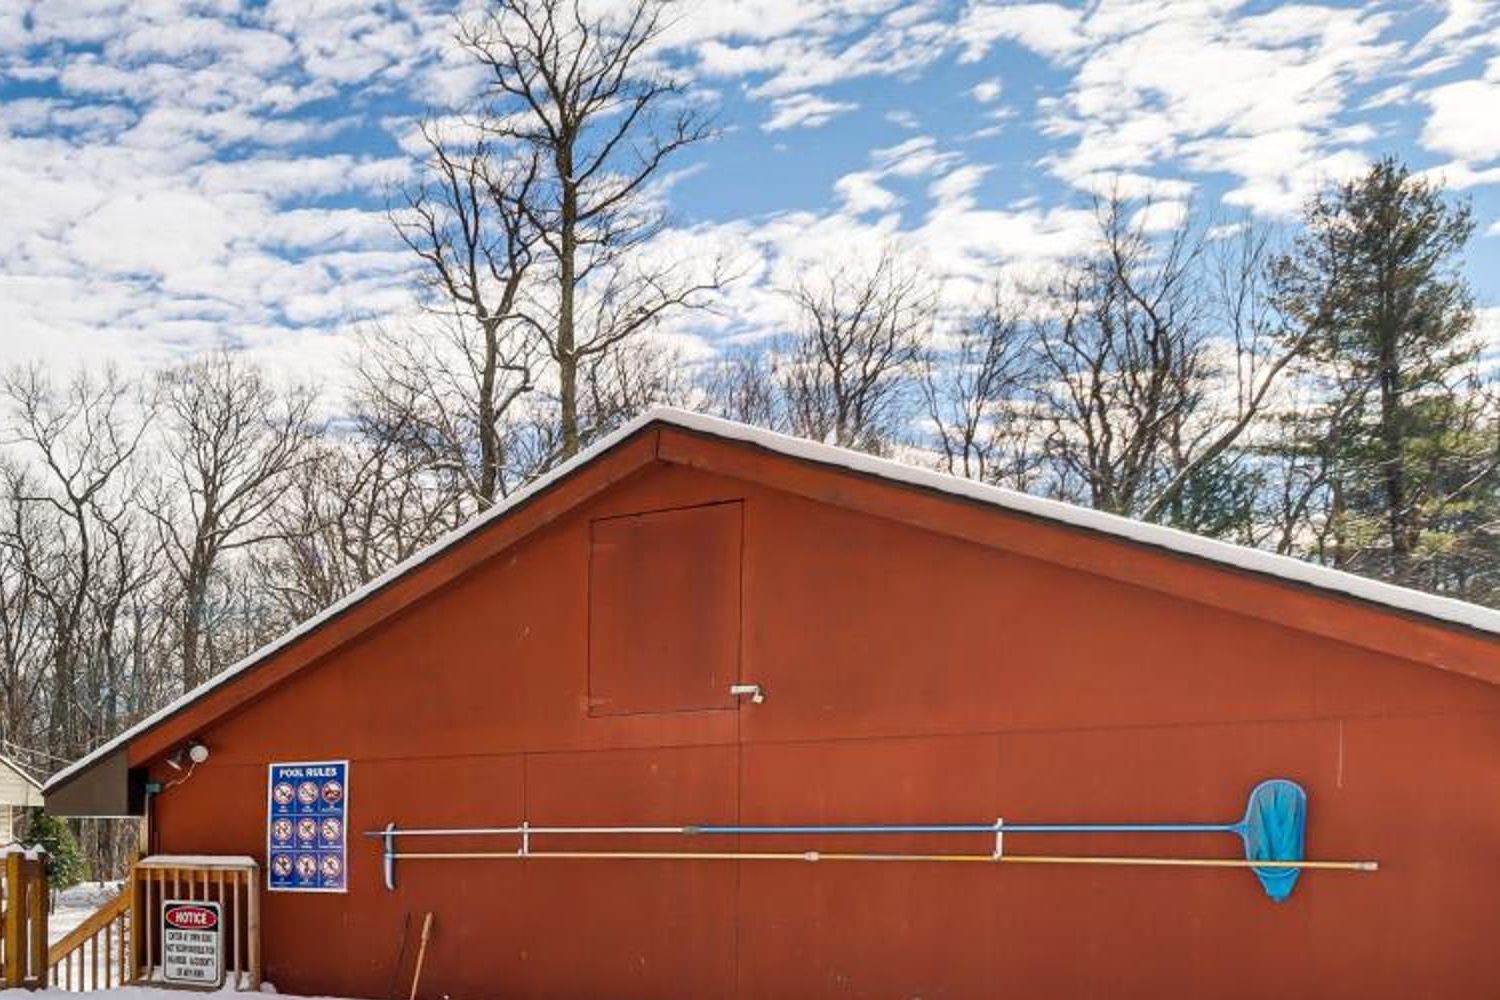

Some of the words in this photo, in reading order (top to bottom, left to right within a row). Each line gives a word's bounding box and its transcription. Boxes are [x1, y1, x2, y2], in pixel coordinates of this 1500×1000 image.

[279, 768, 304, 778] POOL
[306, 767, 337, 777] RULES
[175, 911, 207, 925] NOTICE
